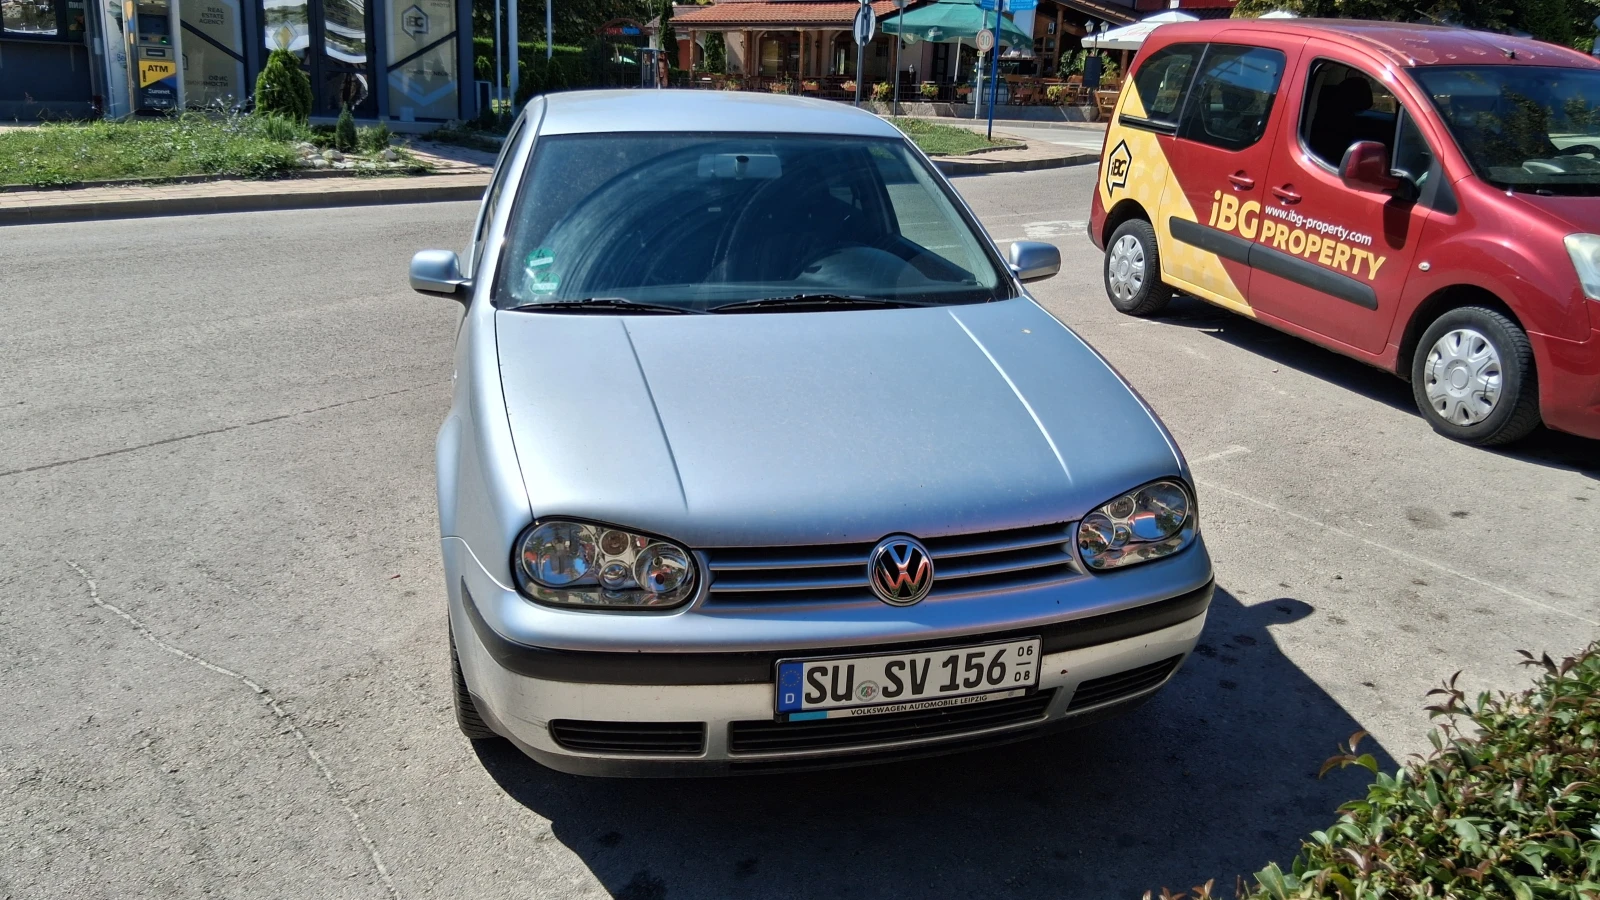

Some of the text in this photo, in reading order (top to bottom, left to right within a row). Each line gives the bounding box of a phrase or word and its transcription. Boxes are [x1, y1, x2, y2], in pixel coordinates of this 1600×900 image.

[980, 34, 990, 46] 30
[147, 65, 169, 73] ATM
[1111, 158, 1127, 178] iBG
[1208, 190, 1261, 239] iBG
[1265, 205, 1372, 246] www.ibg-property.com
[1259, 219, 1387, 281] PROPERTY
[1017, 645, 1033, 657] 06
[804, 649, 1007, 704] SU SV 156
[1014, 670, 1030, 682] 08
[785, 693, 795, 704] D
[850, 694, 988, 716] VOLKSWAGEN AUTOMOBILE LEIPZIG
